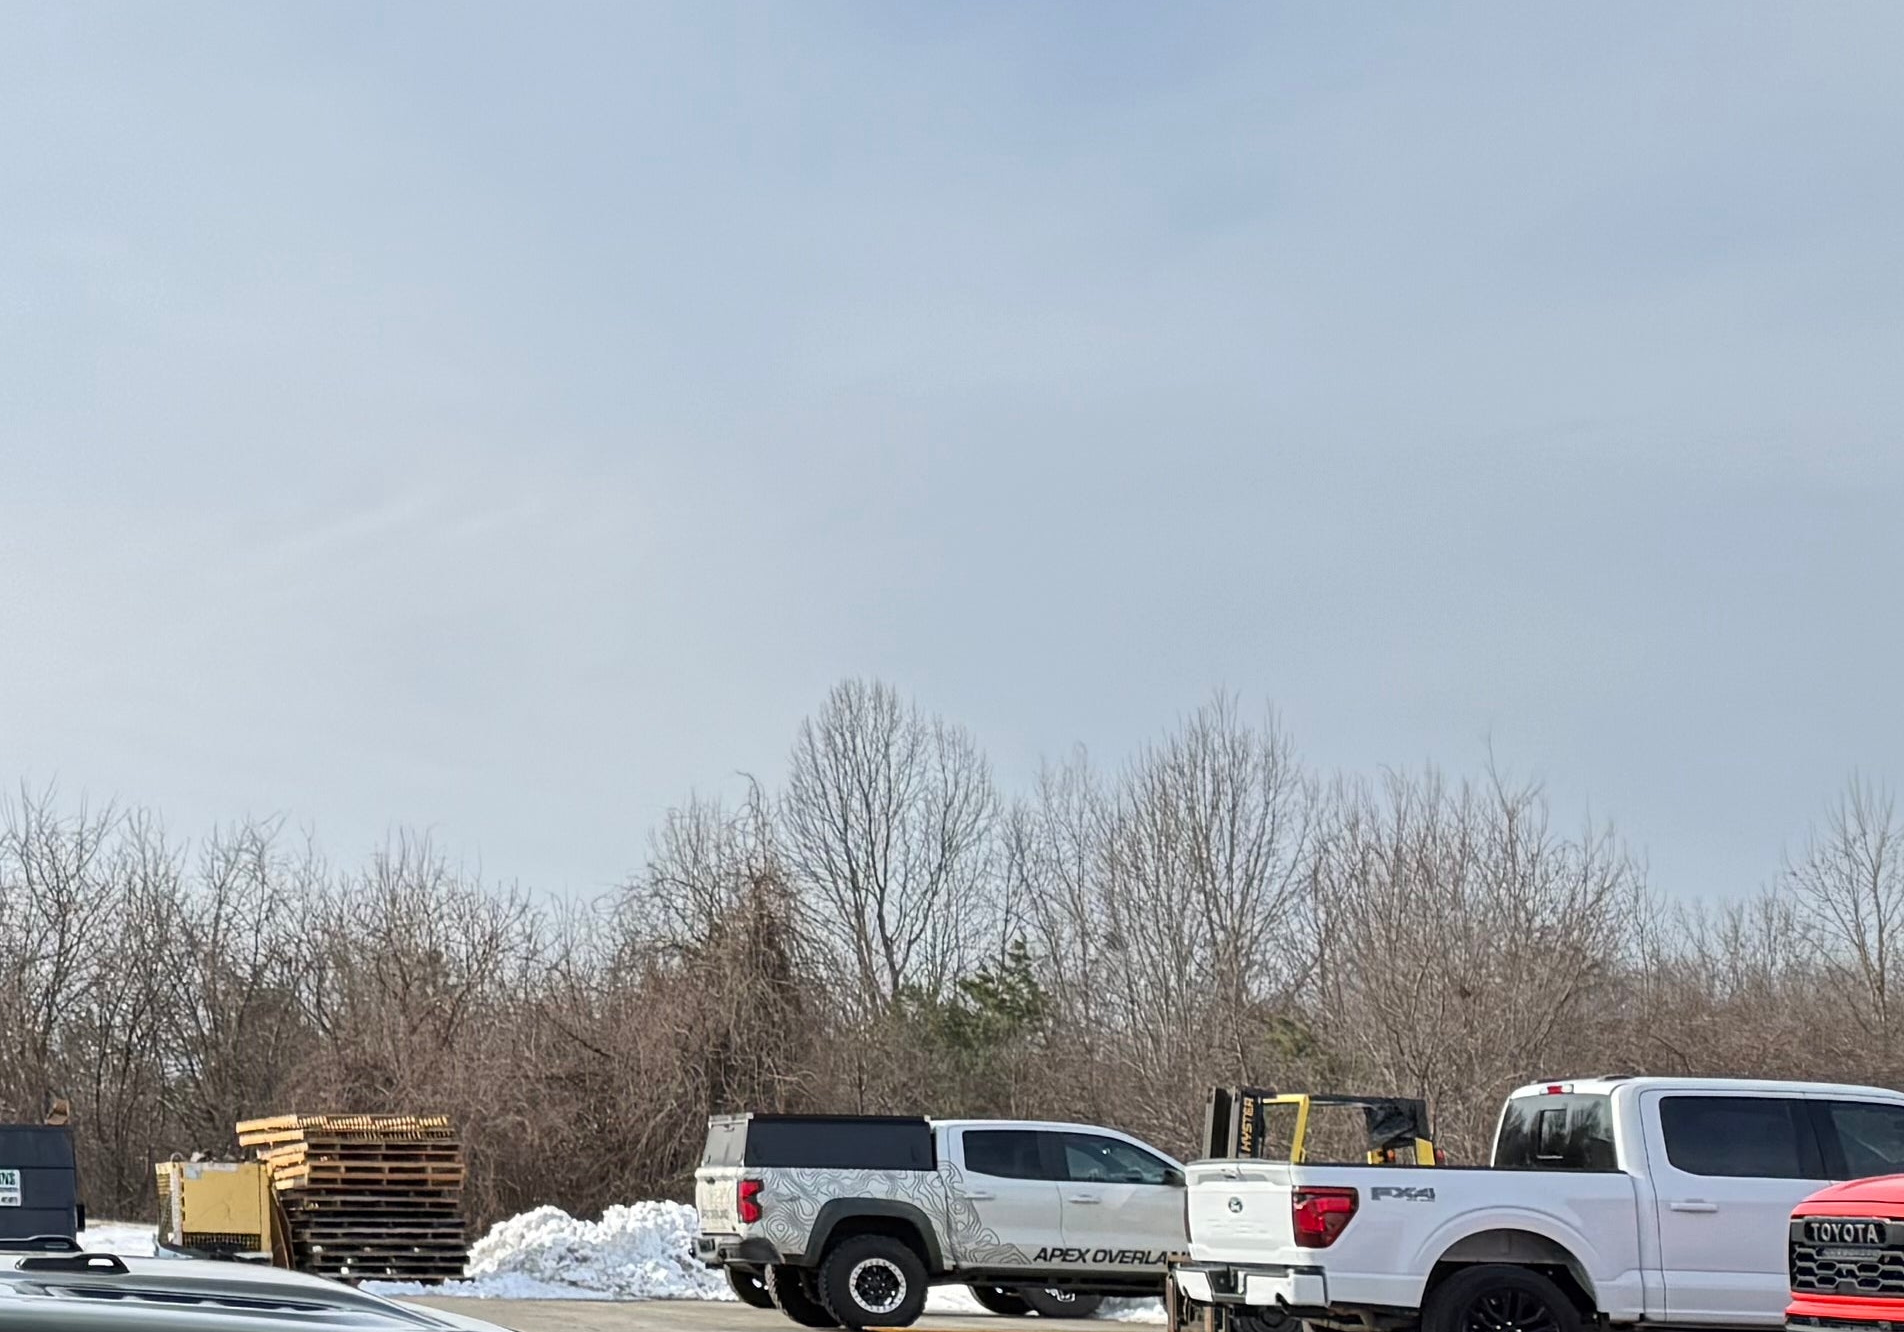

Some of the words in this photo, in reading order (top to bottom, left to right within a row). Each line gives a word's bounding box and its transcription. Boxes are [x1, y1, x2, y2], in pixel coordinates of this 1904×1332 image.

[1241, 1097, 1254, 1152] HYSTER
[1371, 1187, 1436, 1201] FX4
[1810, 1222, 1879, 1243] TOYOTA
[1033, 1247, 1090, 1263] APEX
